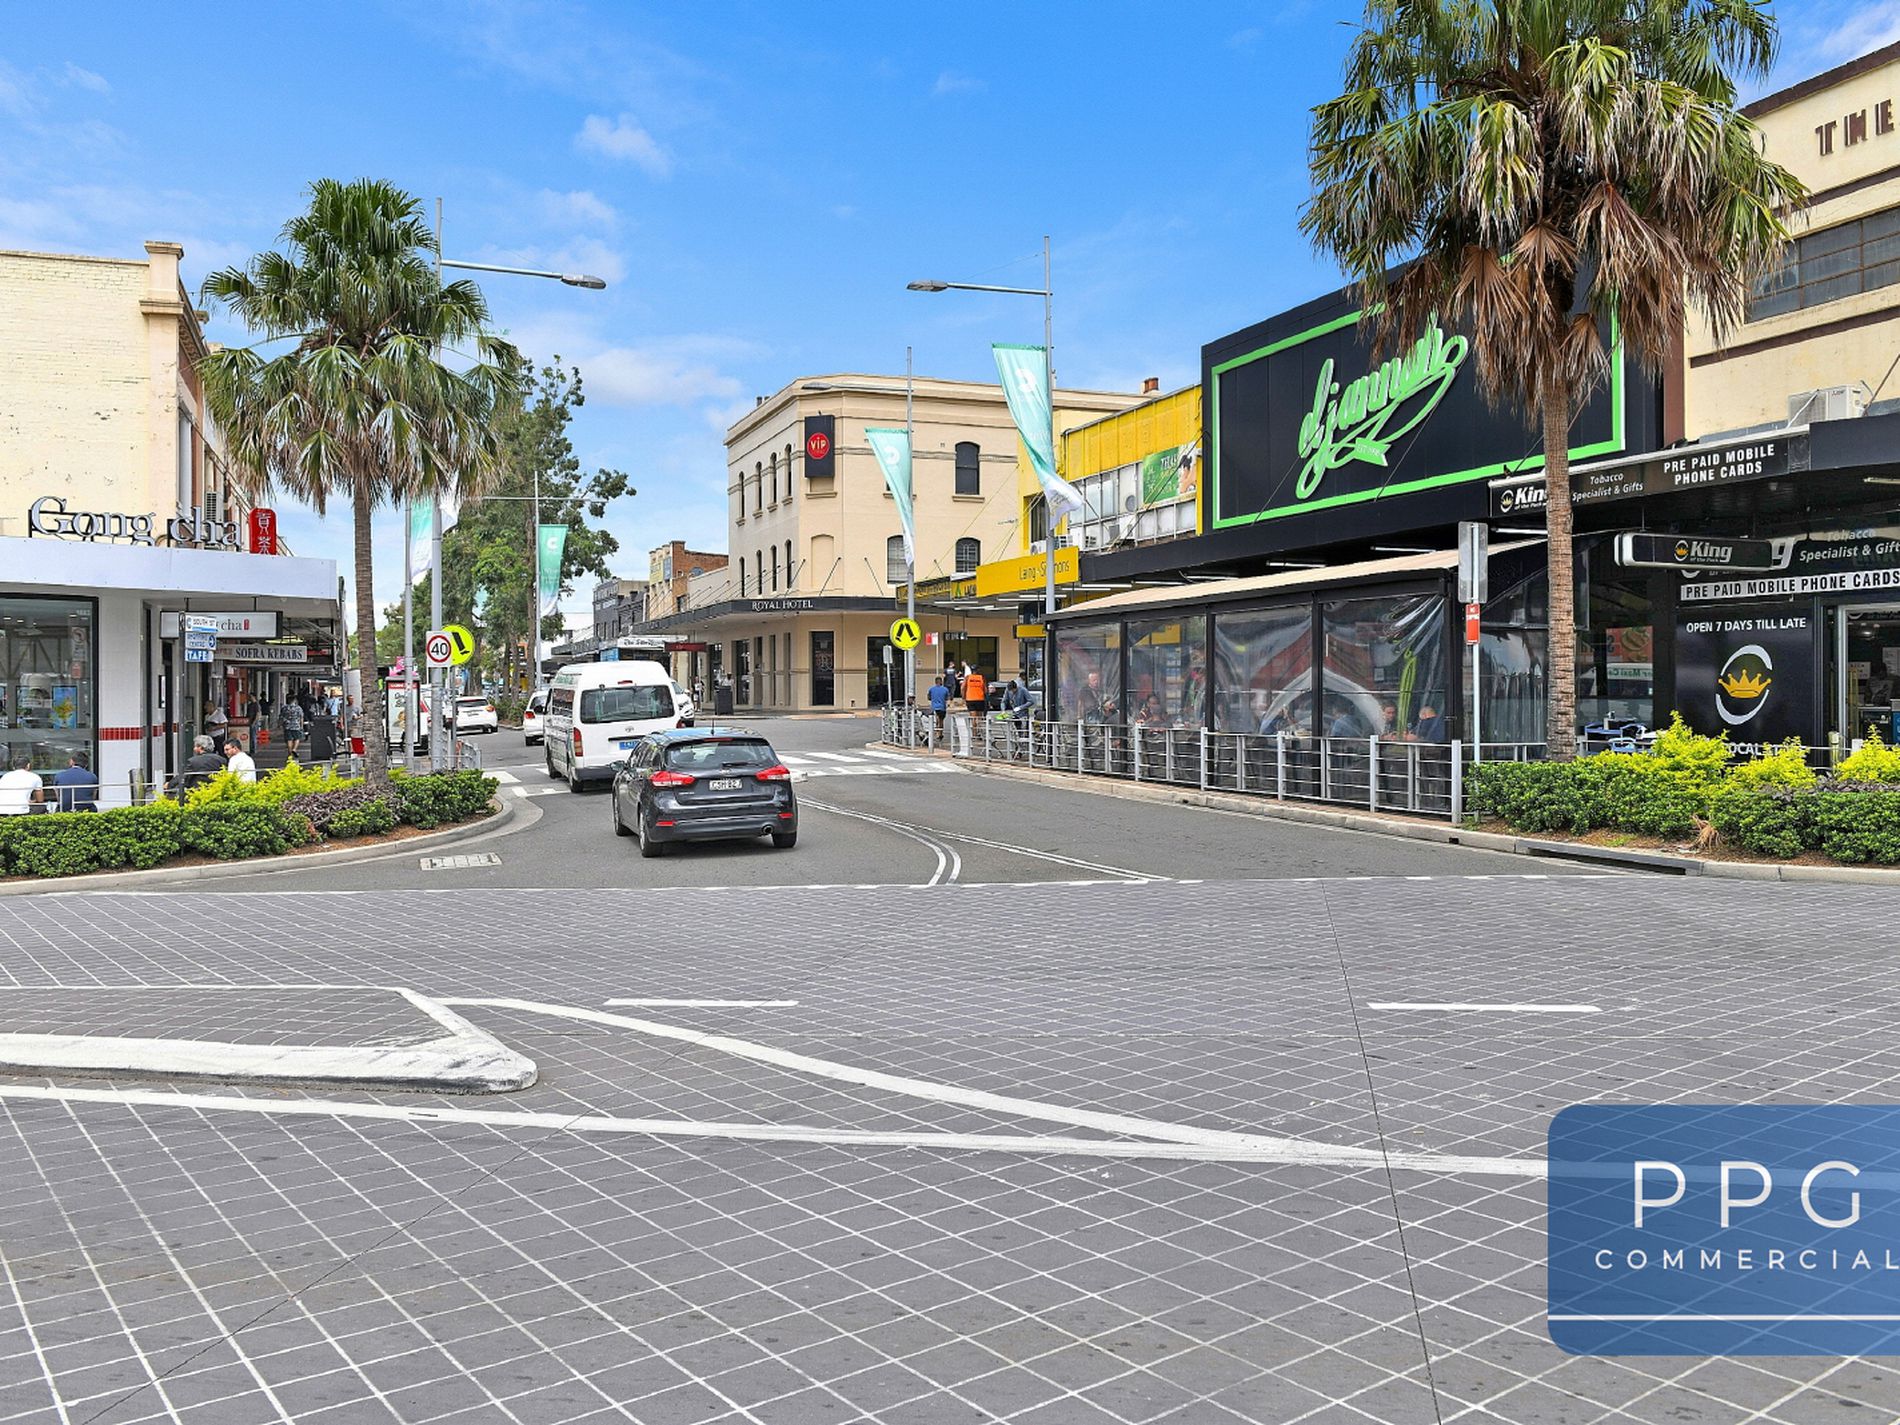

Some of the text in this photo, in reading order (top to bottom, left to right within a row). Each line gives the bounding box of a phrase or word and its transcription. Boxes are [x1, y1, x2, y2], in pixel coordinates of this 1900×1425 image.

[1815, 99, 1895, 156] THE
[1664, 444, 1775, 473] PRE PAID MOBILE
[1590, 473, 1624, 485] Tobacco
[1675, 461, 1762, 485] PHONE CARDS
[1572, 481, 1644, 502] Specialist & Gifts
[30, 495, 243, 546] Gong cha
[1690, 541, 1733, 563] King
[1799, 546, 1858, 562] Specialist
[1862, 544, 1871, 555] &
[1686, 571, 1900, 598] PRE PAID MOBILE PHONE CARDS
[752, 600, 813, 612] ROYAL HOTEL
[221, 619, 242, 631] cha
[1686, 618, 1806, 632] OPEN 7 DAYS TILL LATE
[187, 651, 208, 660] TAFE
[235, 649, 266, 660] SOFRA
[267, 649, 303, 659] KEBABS
[431, 643, 448, 655] 40
